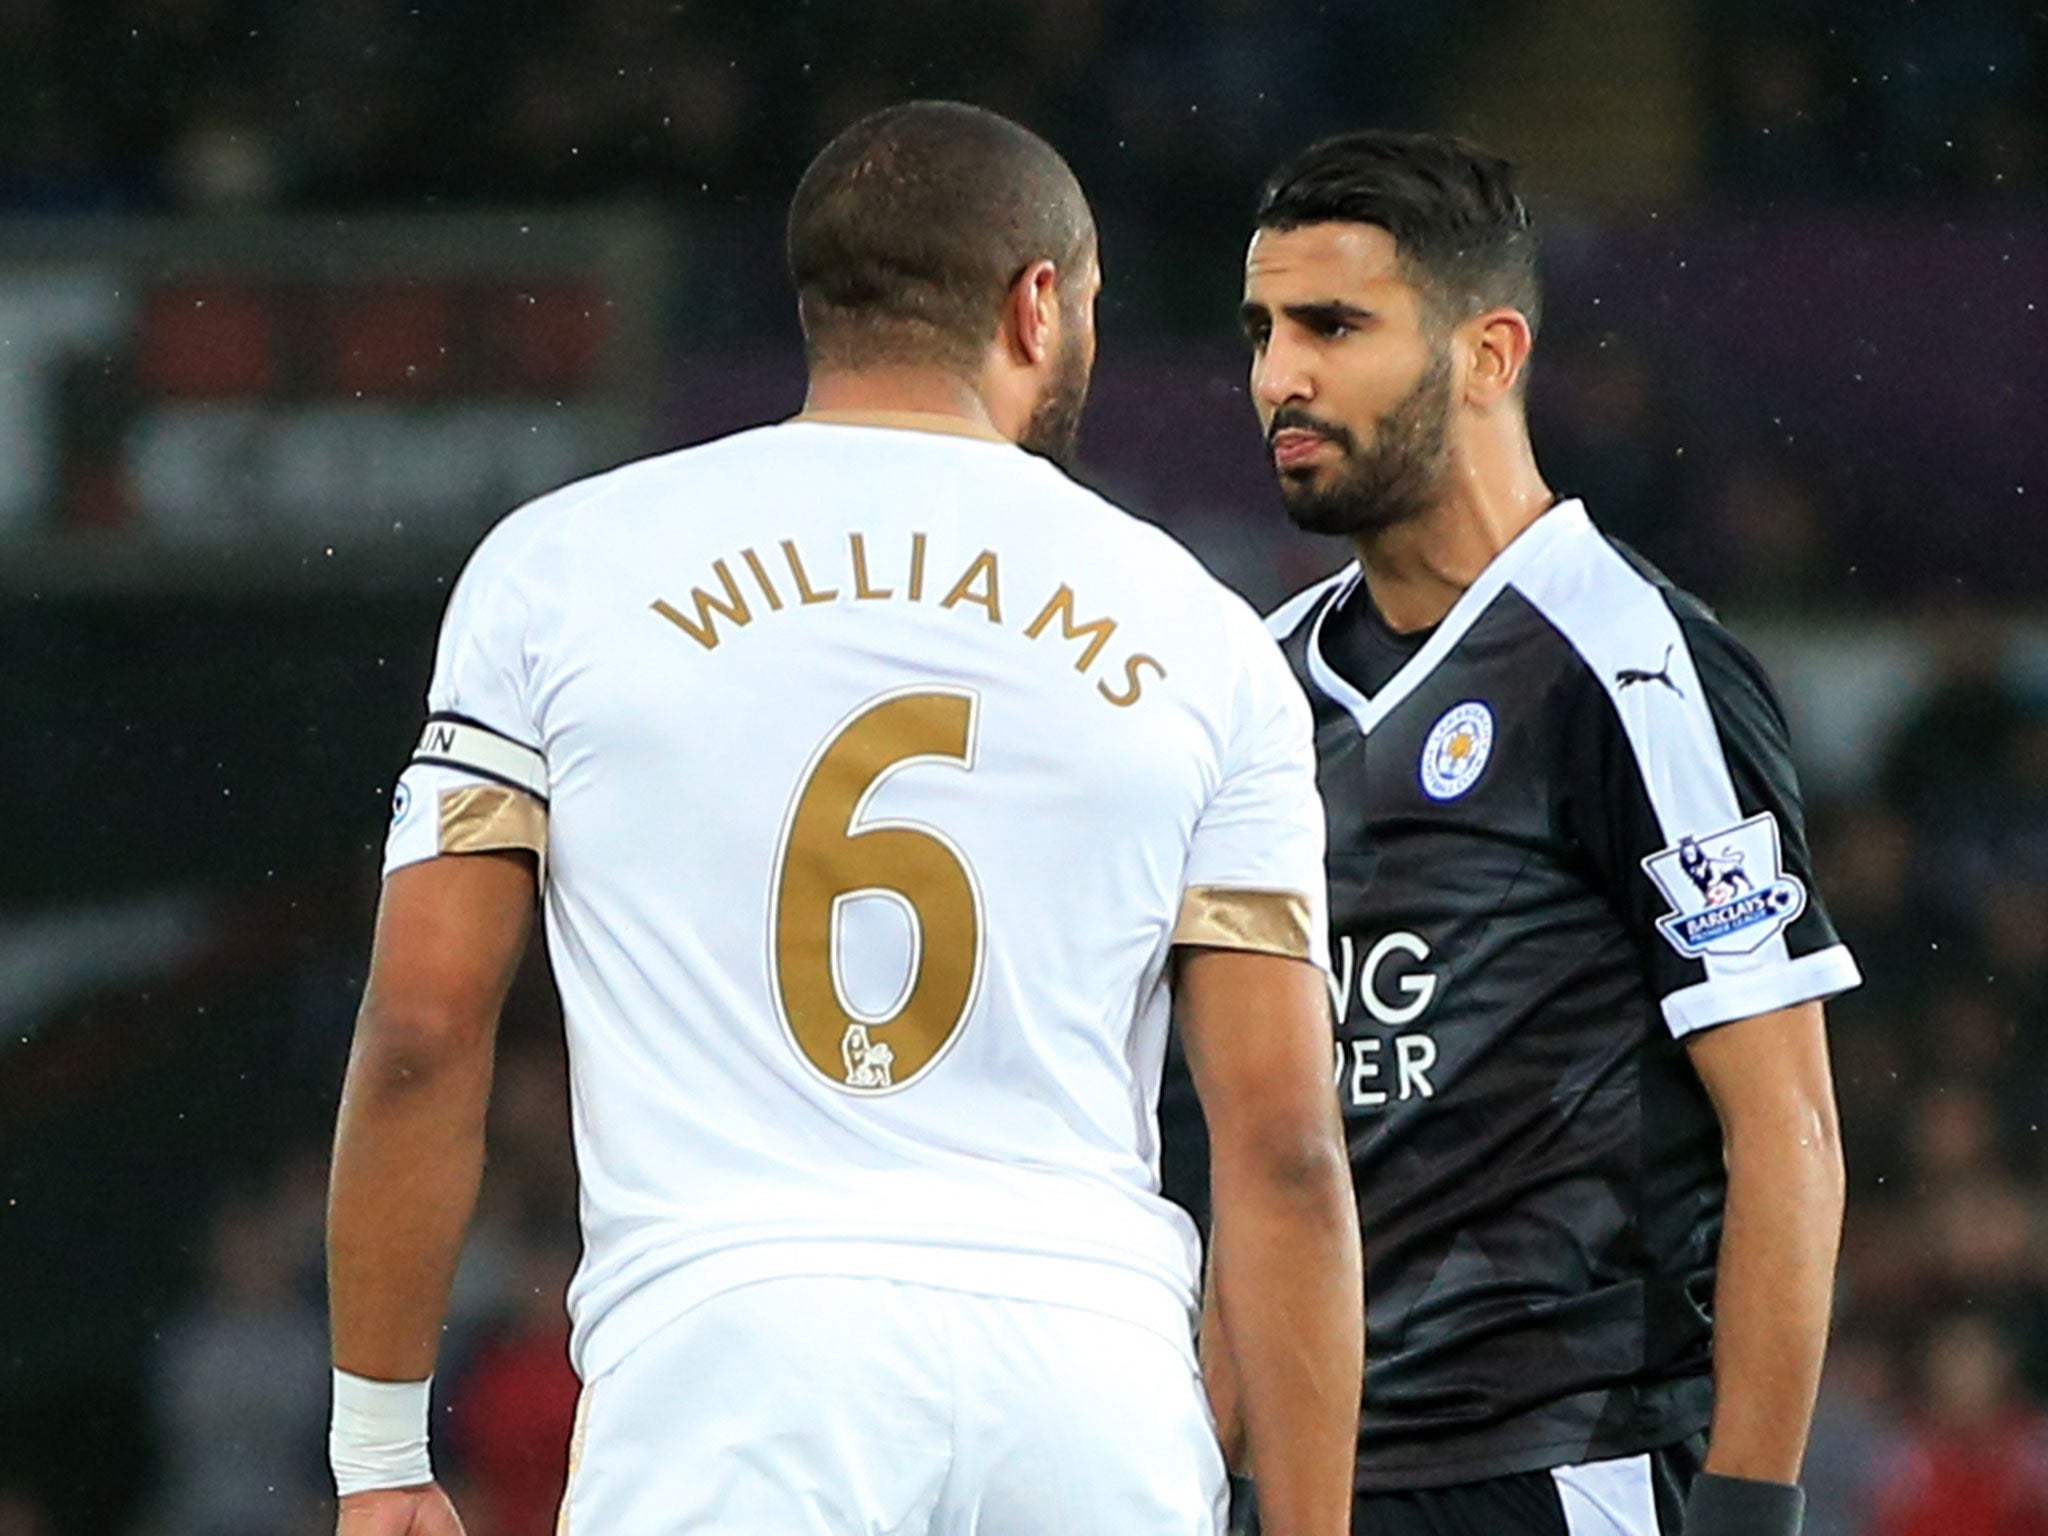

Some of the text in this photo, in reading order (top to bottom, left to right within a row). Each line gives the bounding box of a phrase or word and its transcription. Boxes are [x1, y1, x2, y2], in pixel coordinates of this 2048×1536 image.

[650, 532, 1168, 708] WILLIAMS
[417, 725, 457, 753] IN
[767, 684, 988, 1098] 6
[1686, 893, 1767, 936] BARCLAYS
